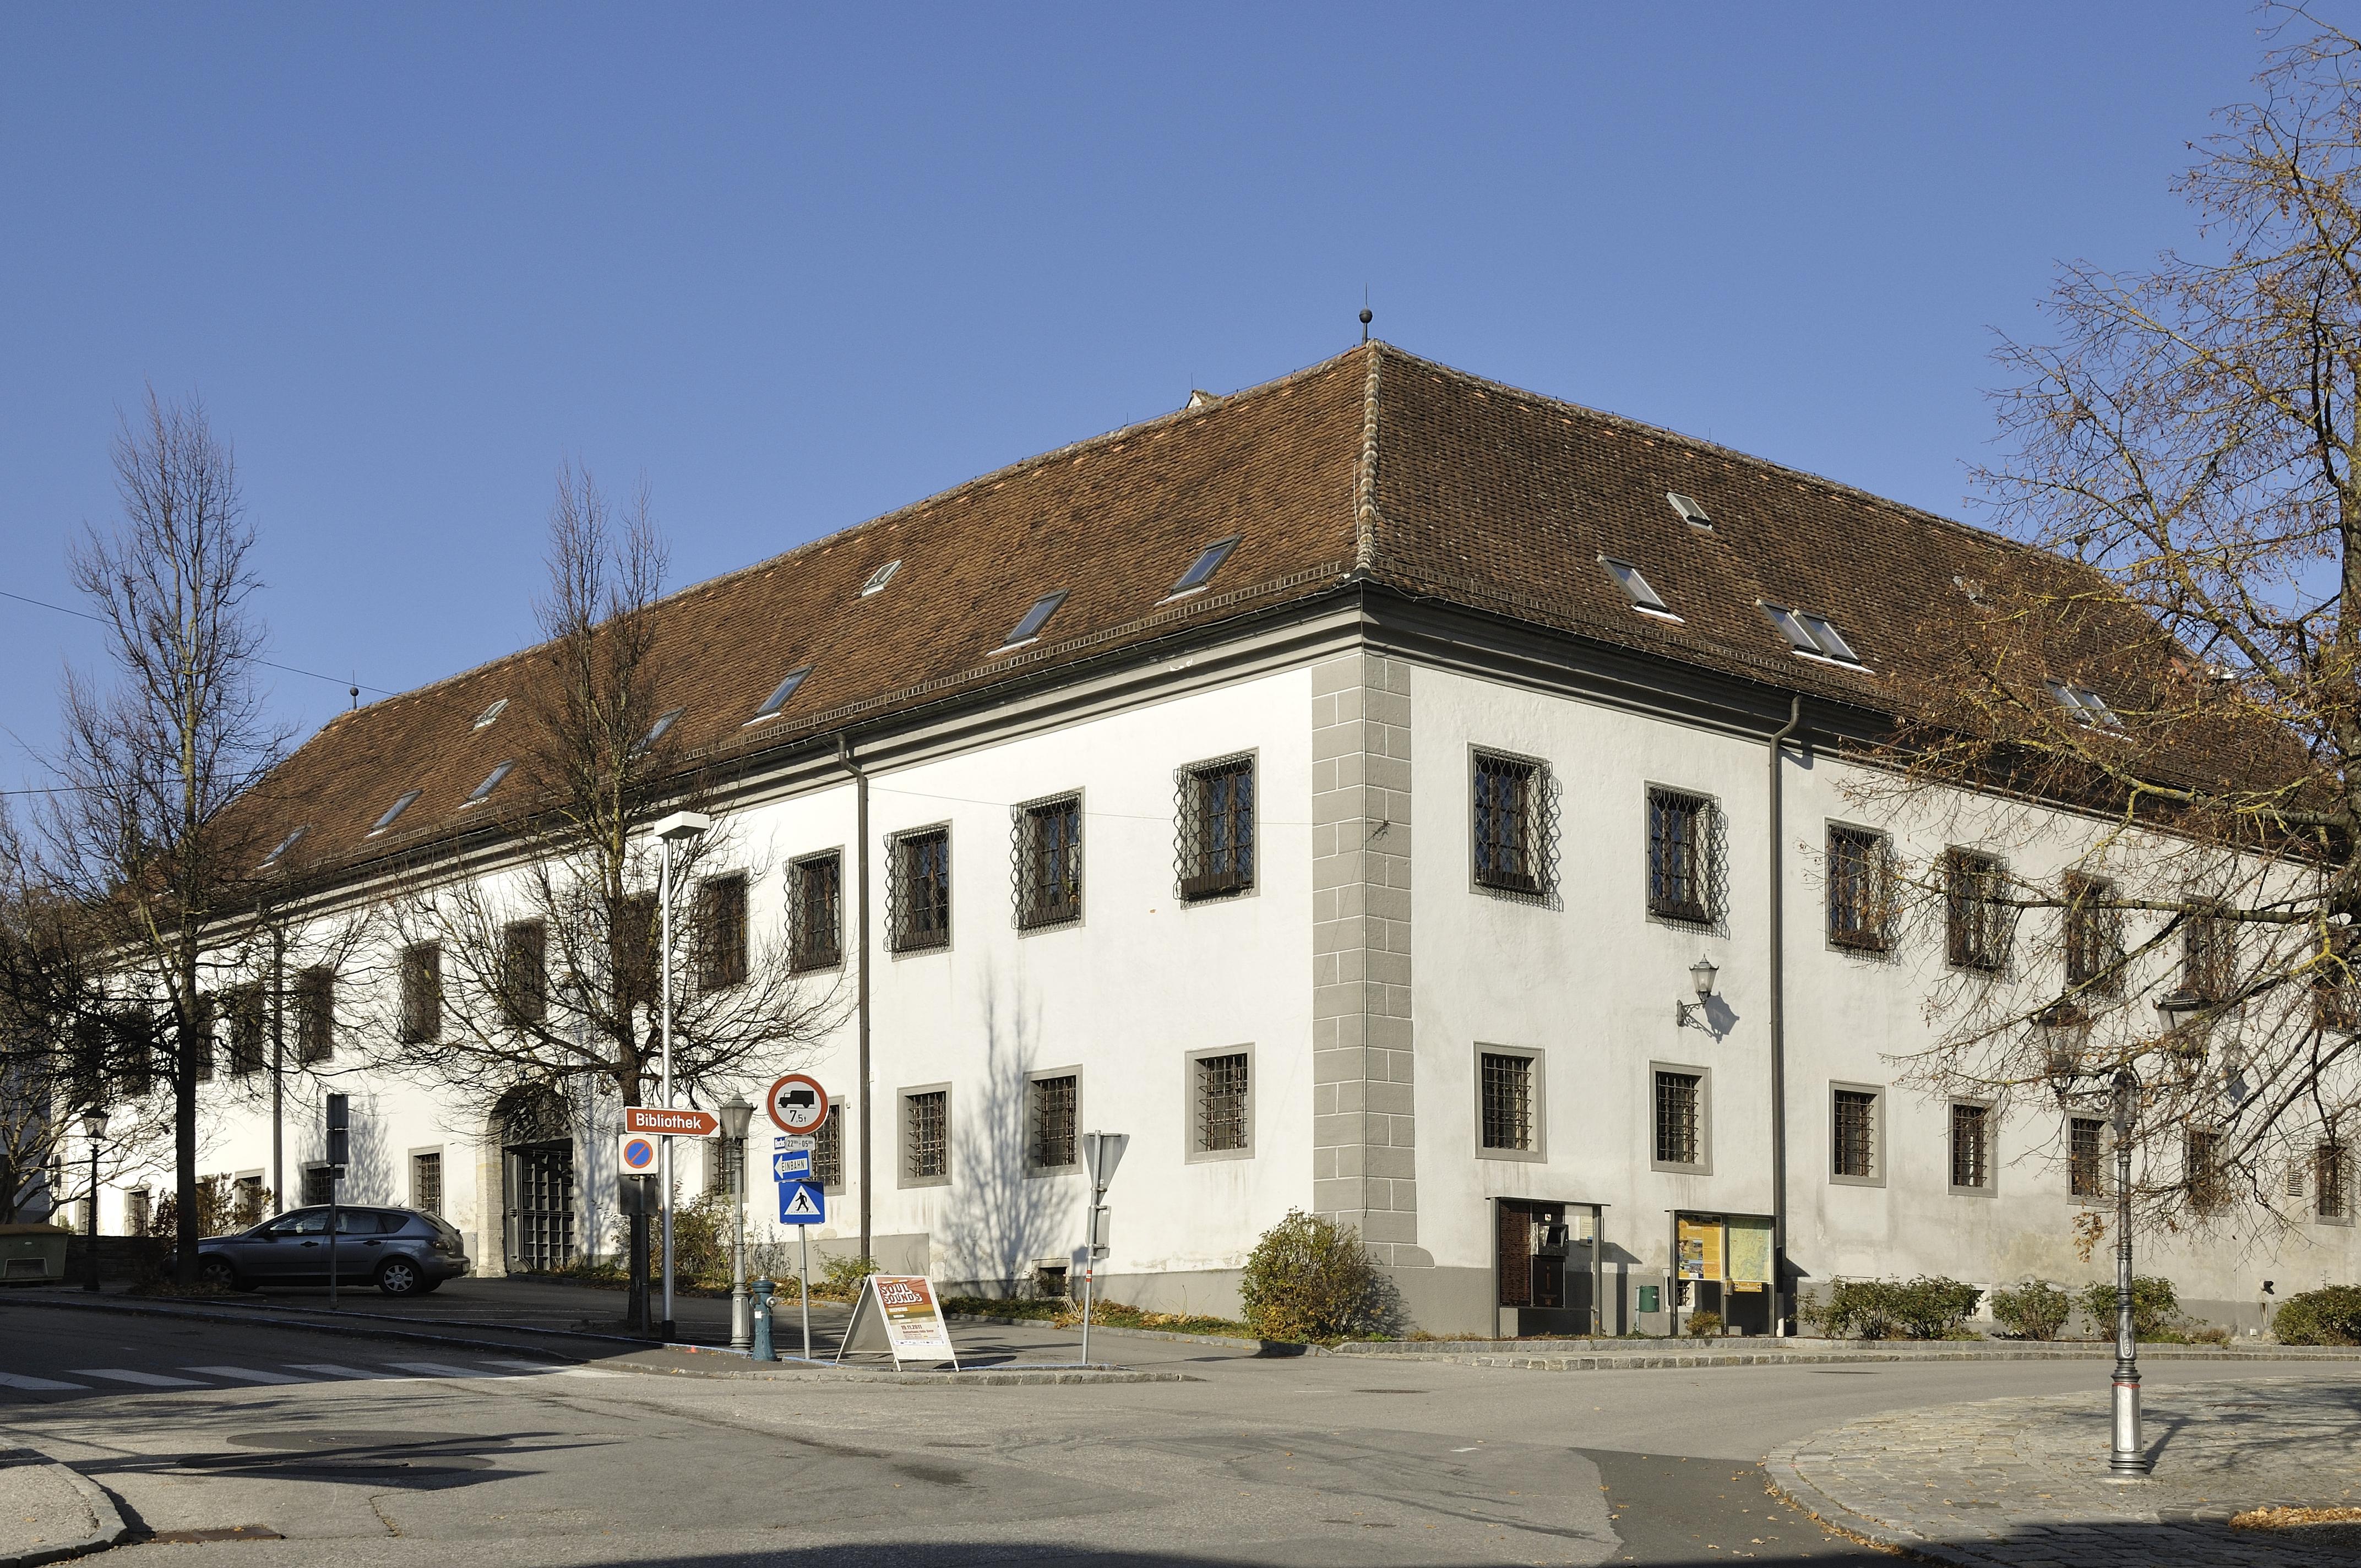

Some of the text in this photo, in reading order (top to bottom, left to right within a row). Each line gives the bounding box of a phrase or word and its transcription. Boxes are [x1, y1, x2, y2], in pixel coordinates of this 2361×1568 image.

[635, 1113, 702, 1129] Bibliothek
[782, 1159, 804, 1172] EINBAHN
[879, 1283, 912, 1296] SOUL
[882, 1292, 922, 1304] SOUNDS
